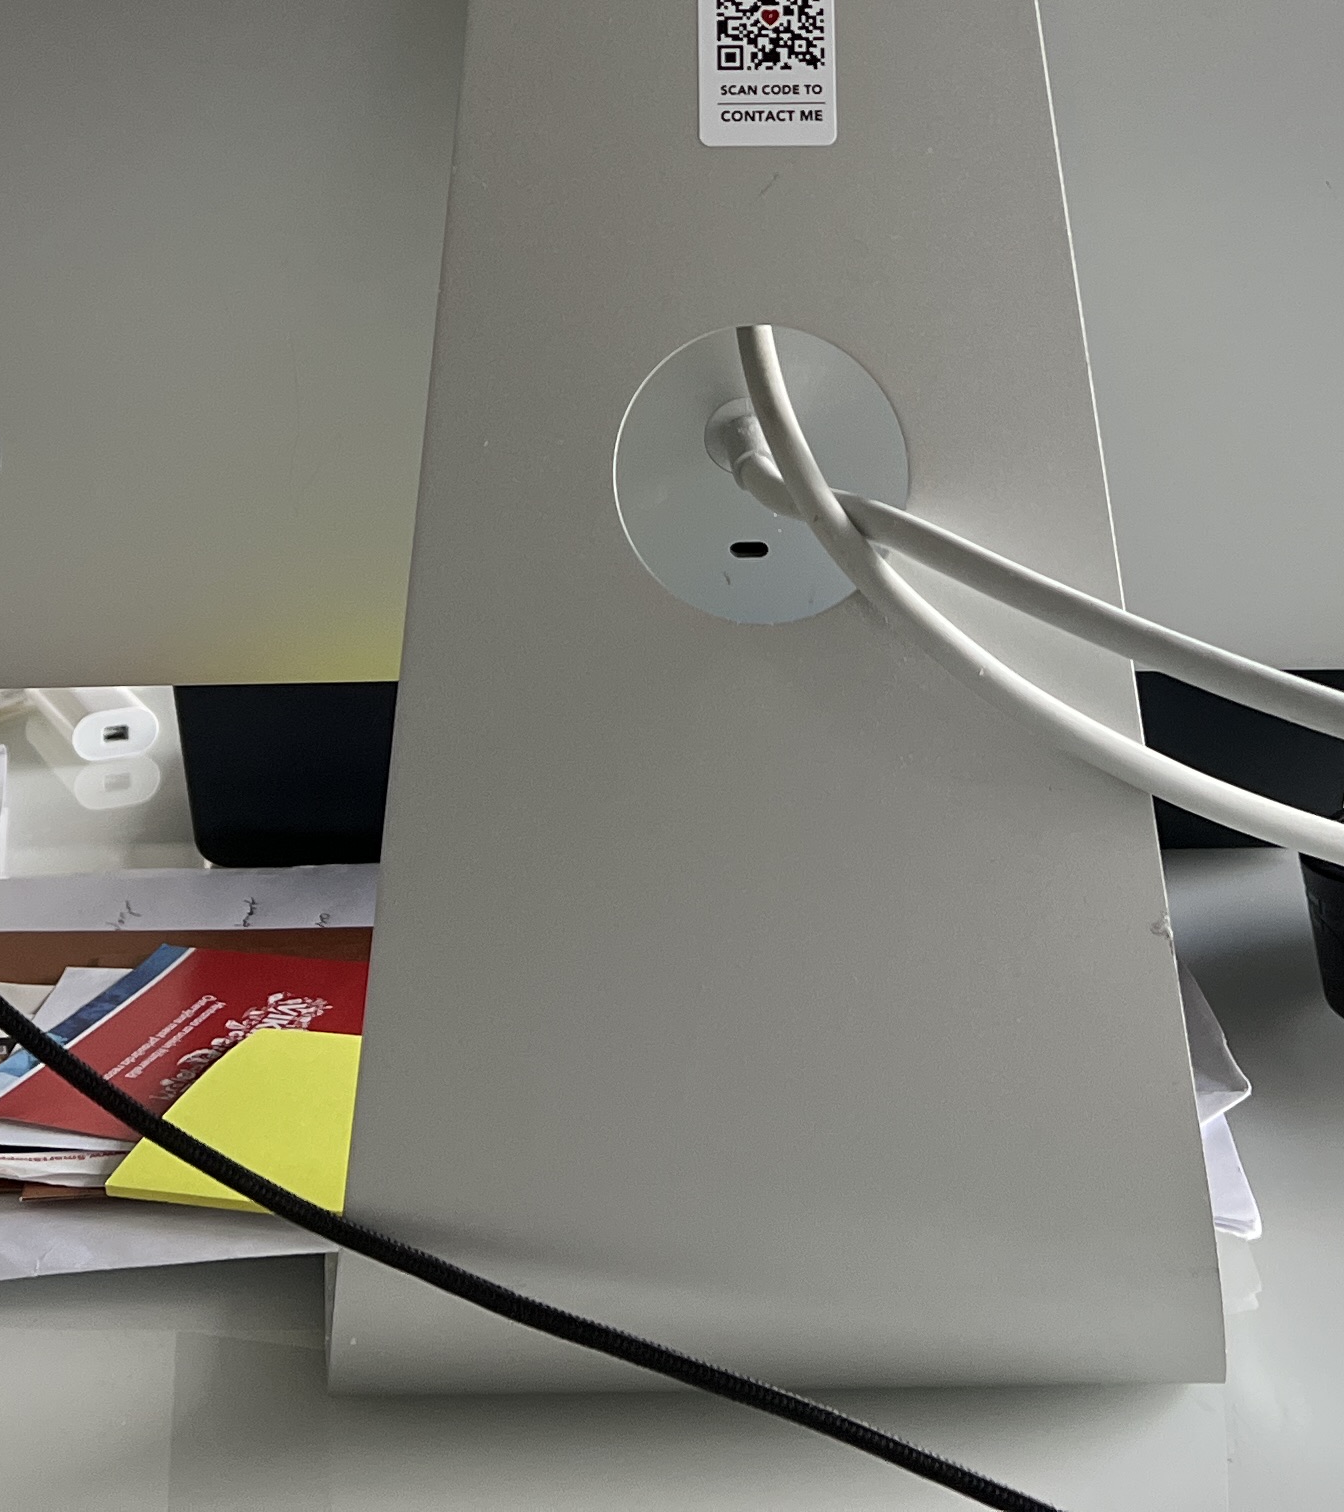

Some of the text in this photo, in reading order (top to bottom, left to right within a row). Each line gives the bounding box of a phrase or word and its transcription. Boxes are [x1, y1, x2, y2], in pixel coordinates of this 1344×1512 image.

[720, 84, 823, 96] SCAN CODE TO
[720, 109, 823, 122] CONTACT ME
